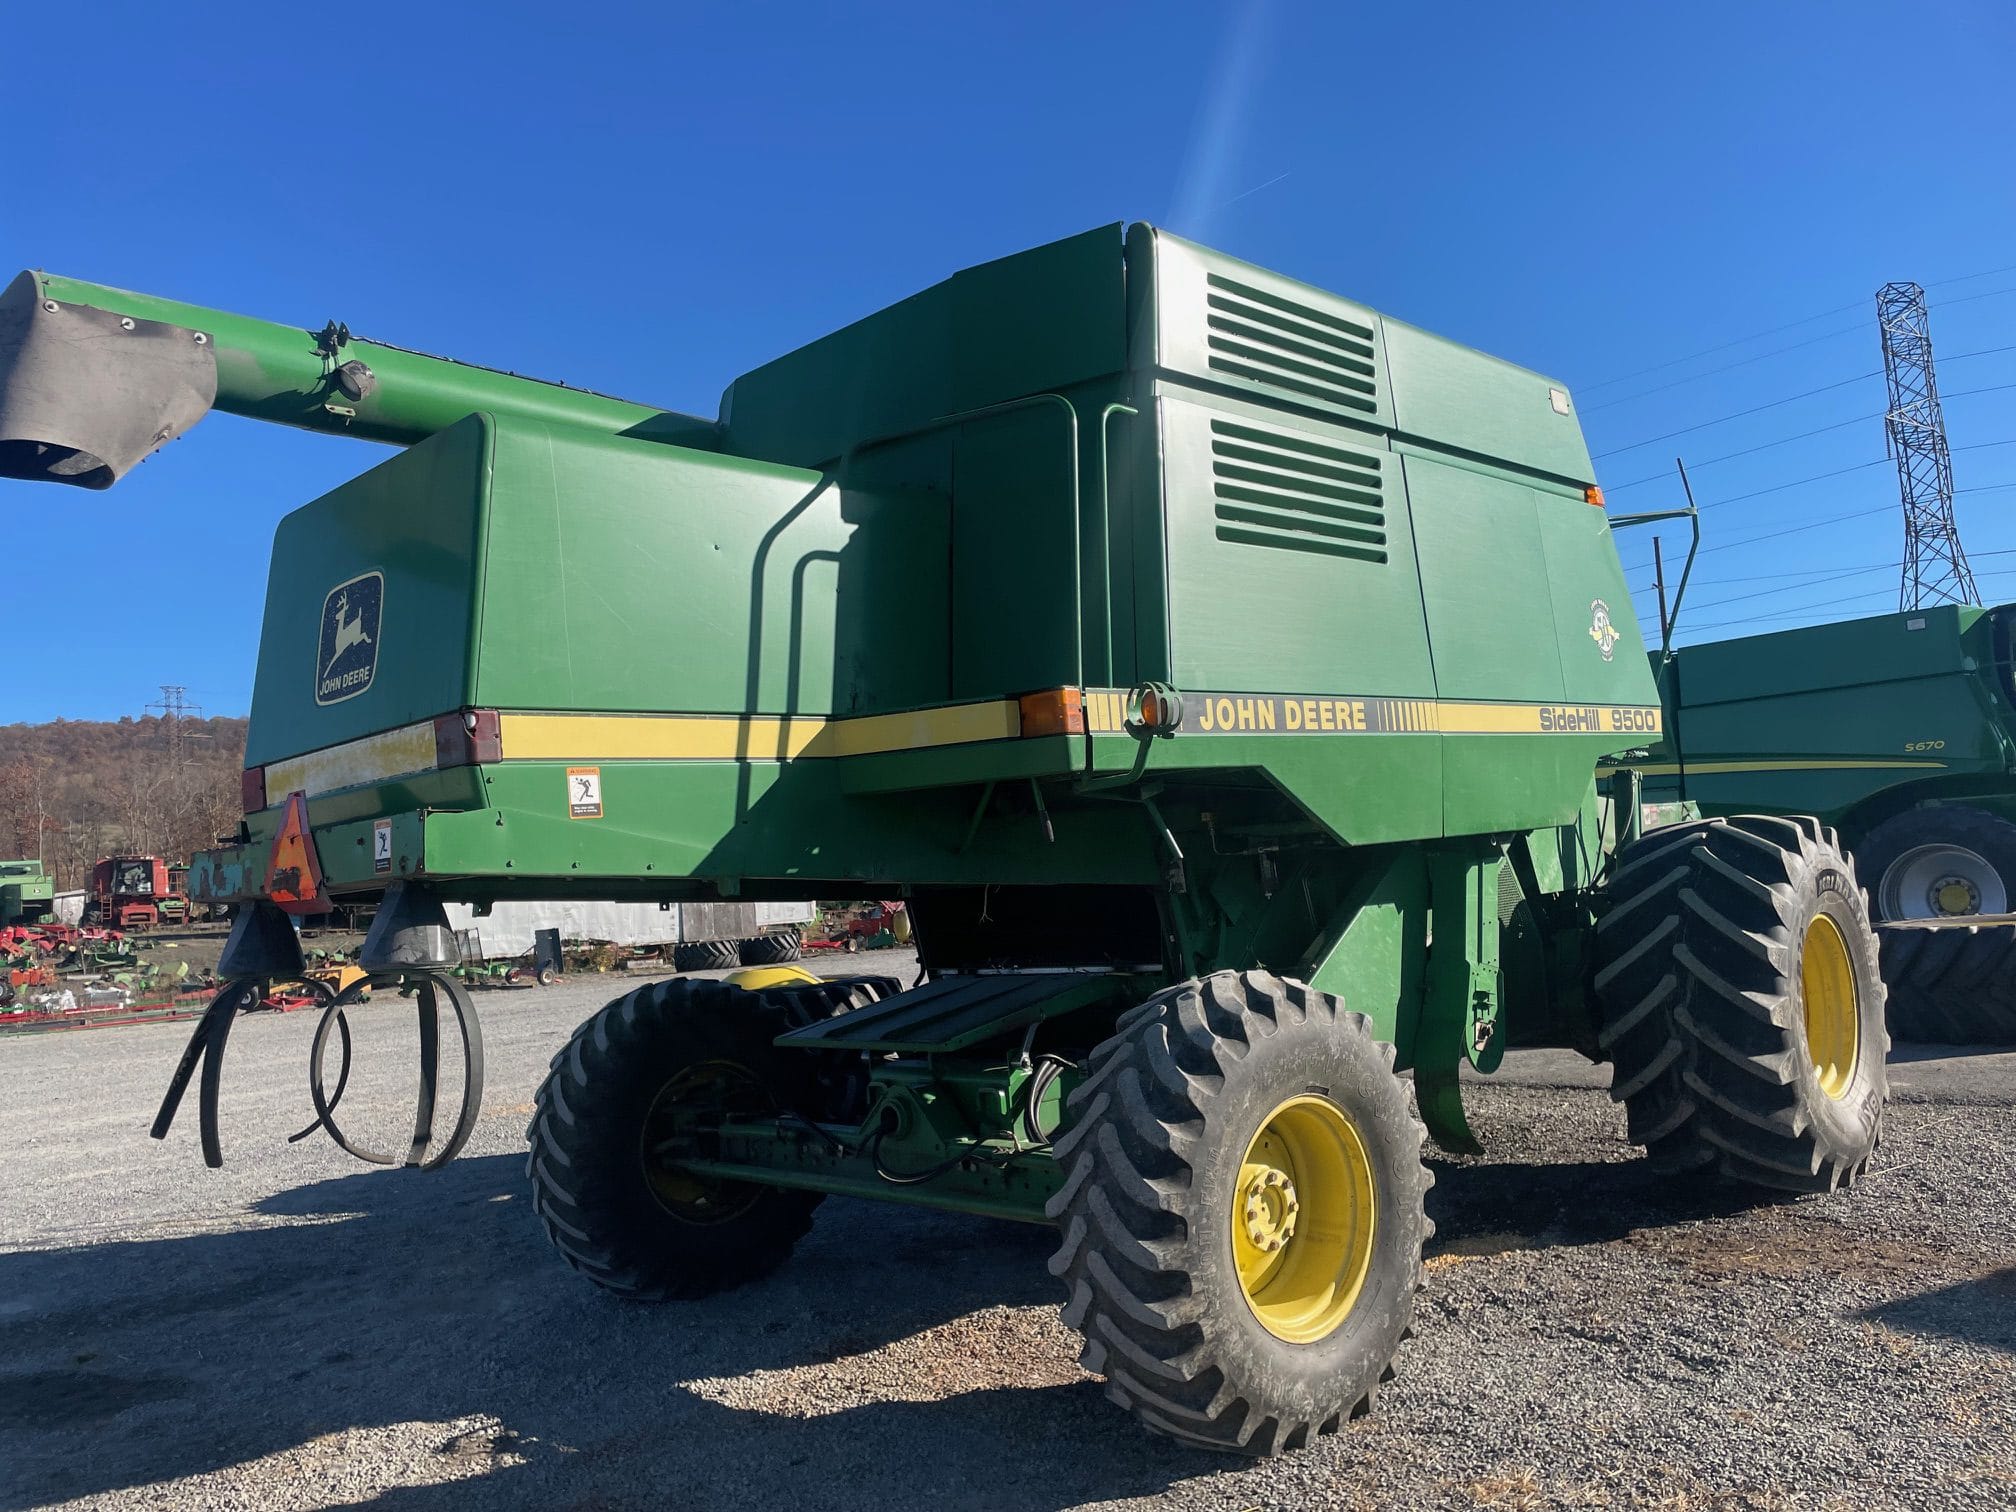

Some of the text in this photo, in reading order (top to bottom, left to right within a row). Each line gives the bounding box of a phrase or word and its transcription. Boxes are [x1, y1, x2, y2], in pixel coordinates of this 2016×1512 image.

[320, 666, 370, 696] JOHN DEERE
[1200, 698, 1367, 731] JOHN DEERE
[1540, 708, 1655, 731] SideHill 9500
[1904, 740, 1945, 752] S670
